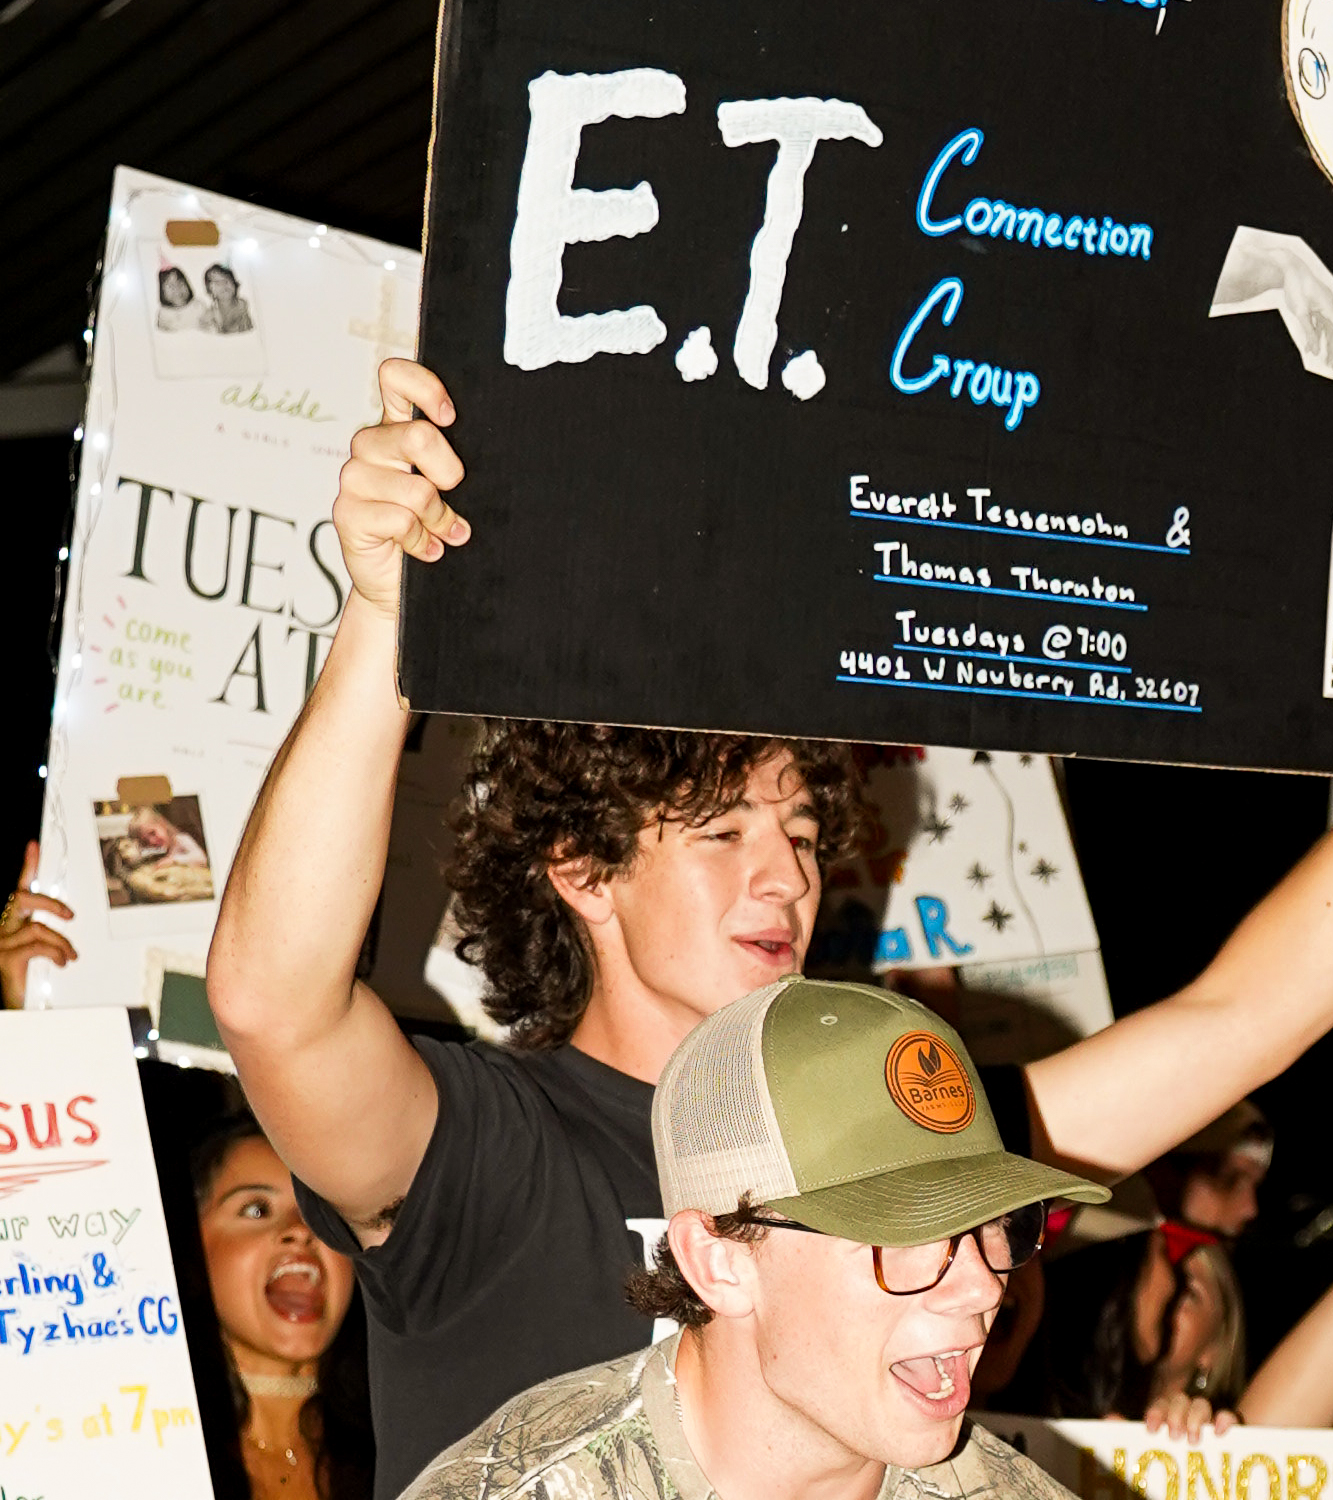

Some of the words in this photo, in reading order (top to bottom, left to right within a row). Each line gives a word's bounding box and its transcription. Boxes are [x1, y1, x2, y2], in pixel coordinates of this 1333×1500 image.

[916, 127, 1153, 261] Connection
[504, 68, 883, 400] E.T.
[890, 277, 1040, 431] Group
[220, 382, 338, 423] abide
[850, 475, 956, 520] Everett
[967, 488, 1128, 539] Tessensohn
[1166, 506, 1191, 548] &
[874, 542, 991, 587] Thomas
[1011, 566, 1135, 602] Thornton
[125, 619, 193, 653] come
[895, 610, 1025, 656] Tuesdays
[109, 645, 137, 666] as
[150, 653, 195, 682] you
[840, 651, 911, 681] 4401
[924, 657, 946, 681] W
[1135, 677, 1200, 706] 32607
[909, 1086, 965, 1104] Barnes
[48, 1208, 141, 1245] way
[0, 1263, 84, 1306] rling
[93, 1253, 115, 1288] &
[138, 1296, 178, 1336] CG
[82, 1402, 113, 1440] at
